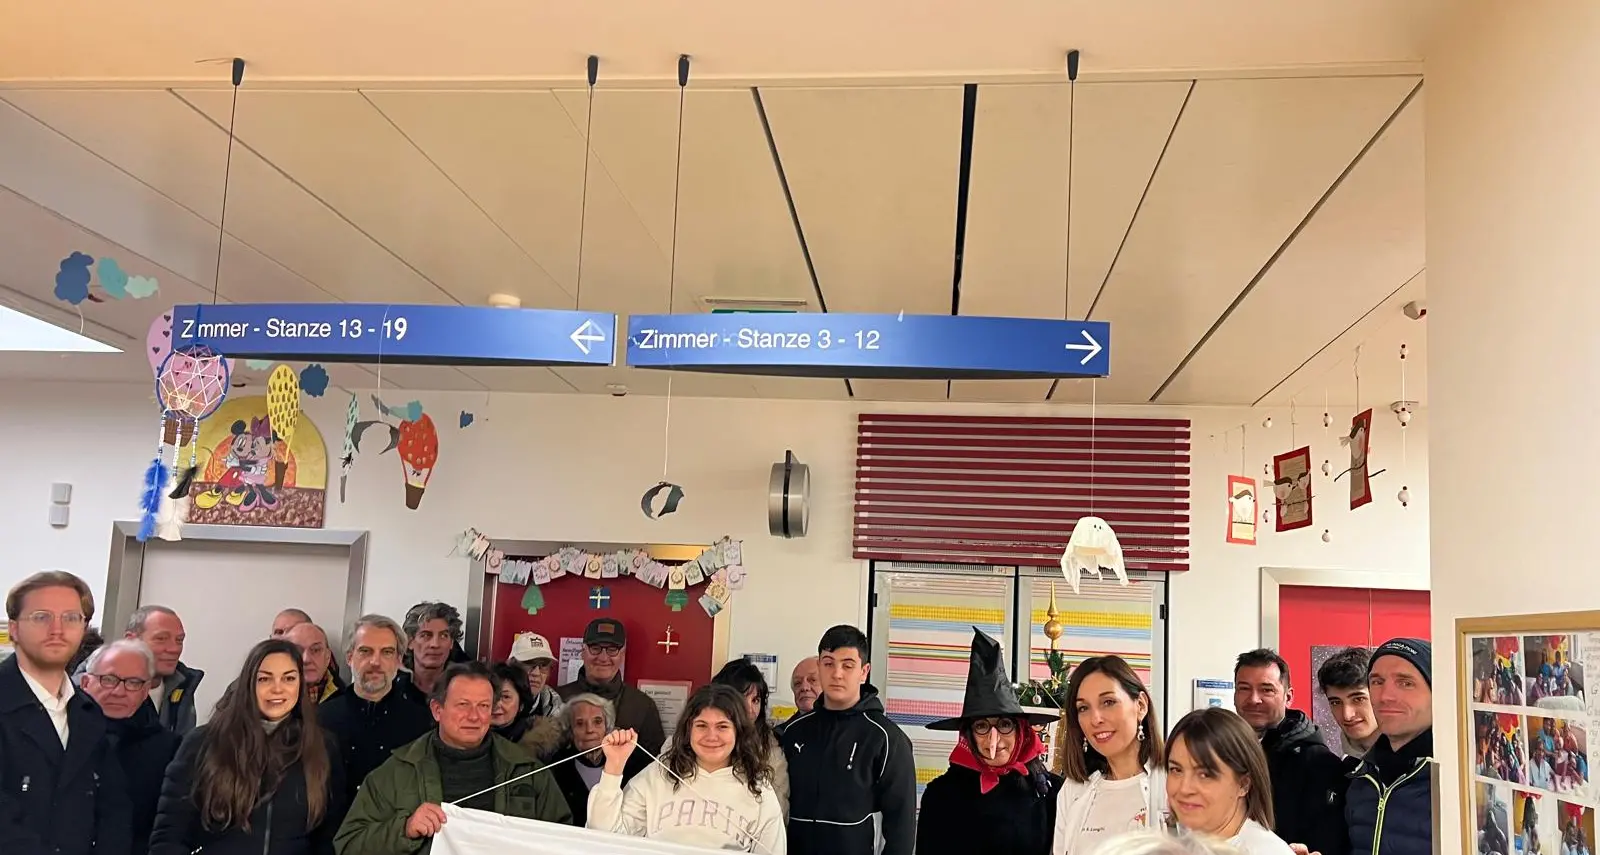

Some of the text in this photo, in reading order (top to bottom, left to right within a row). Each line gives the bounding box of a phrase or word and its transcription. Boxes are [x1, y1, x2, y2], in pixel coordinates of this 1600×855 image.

[181, 319, 249, 338] Zmmer
[266, 318, 332, 338] Stanze
[339, 319, 362, 338] 13
[383, 317, 408, 341] 19
[639, 329, 718, 349] Zimmer
[738, 328, 811, 349] Stanze
[818, 329, 831, 349] 3
[854, 330, 880, 350] 12
